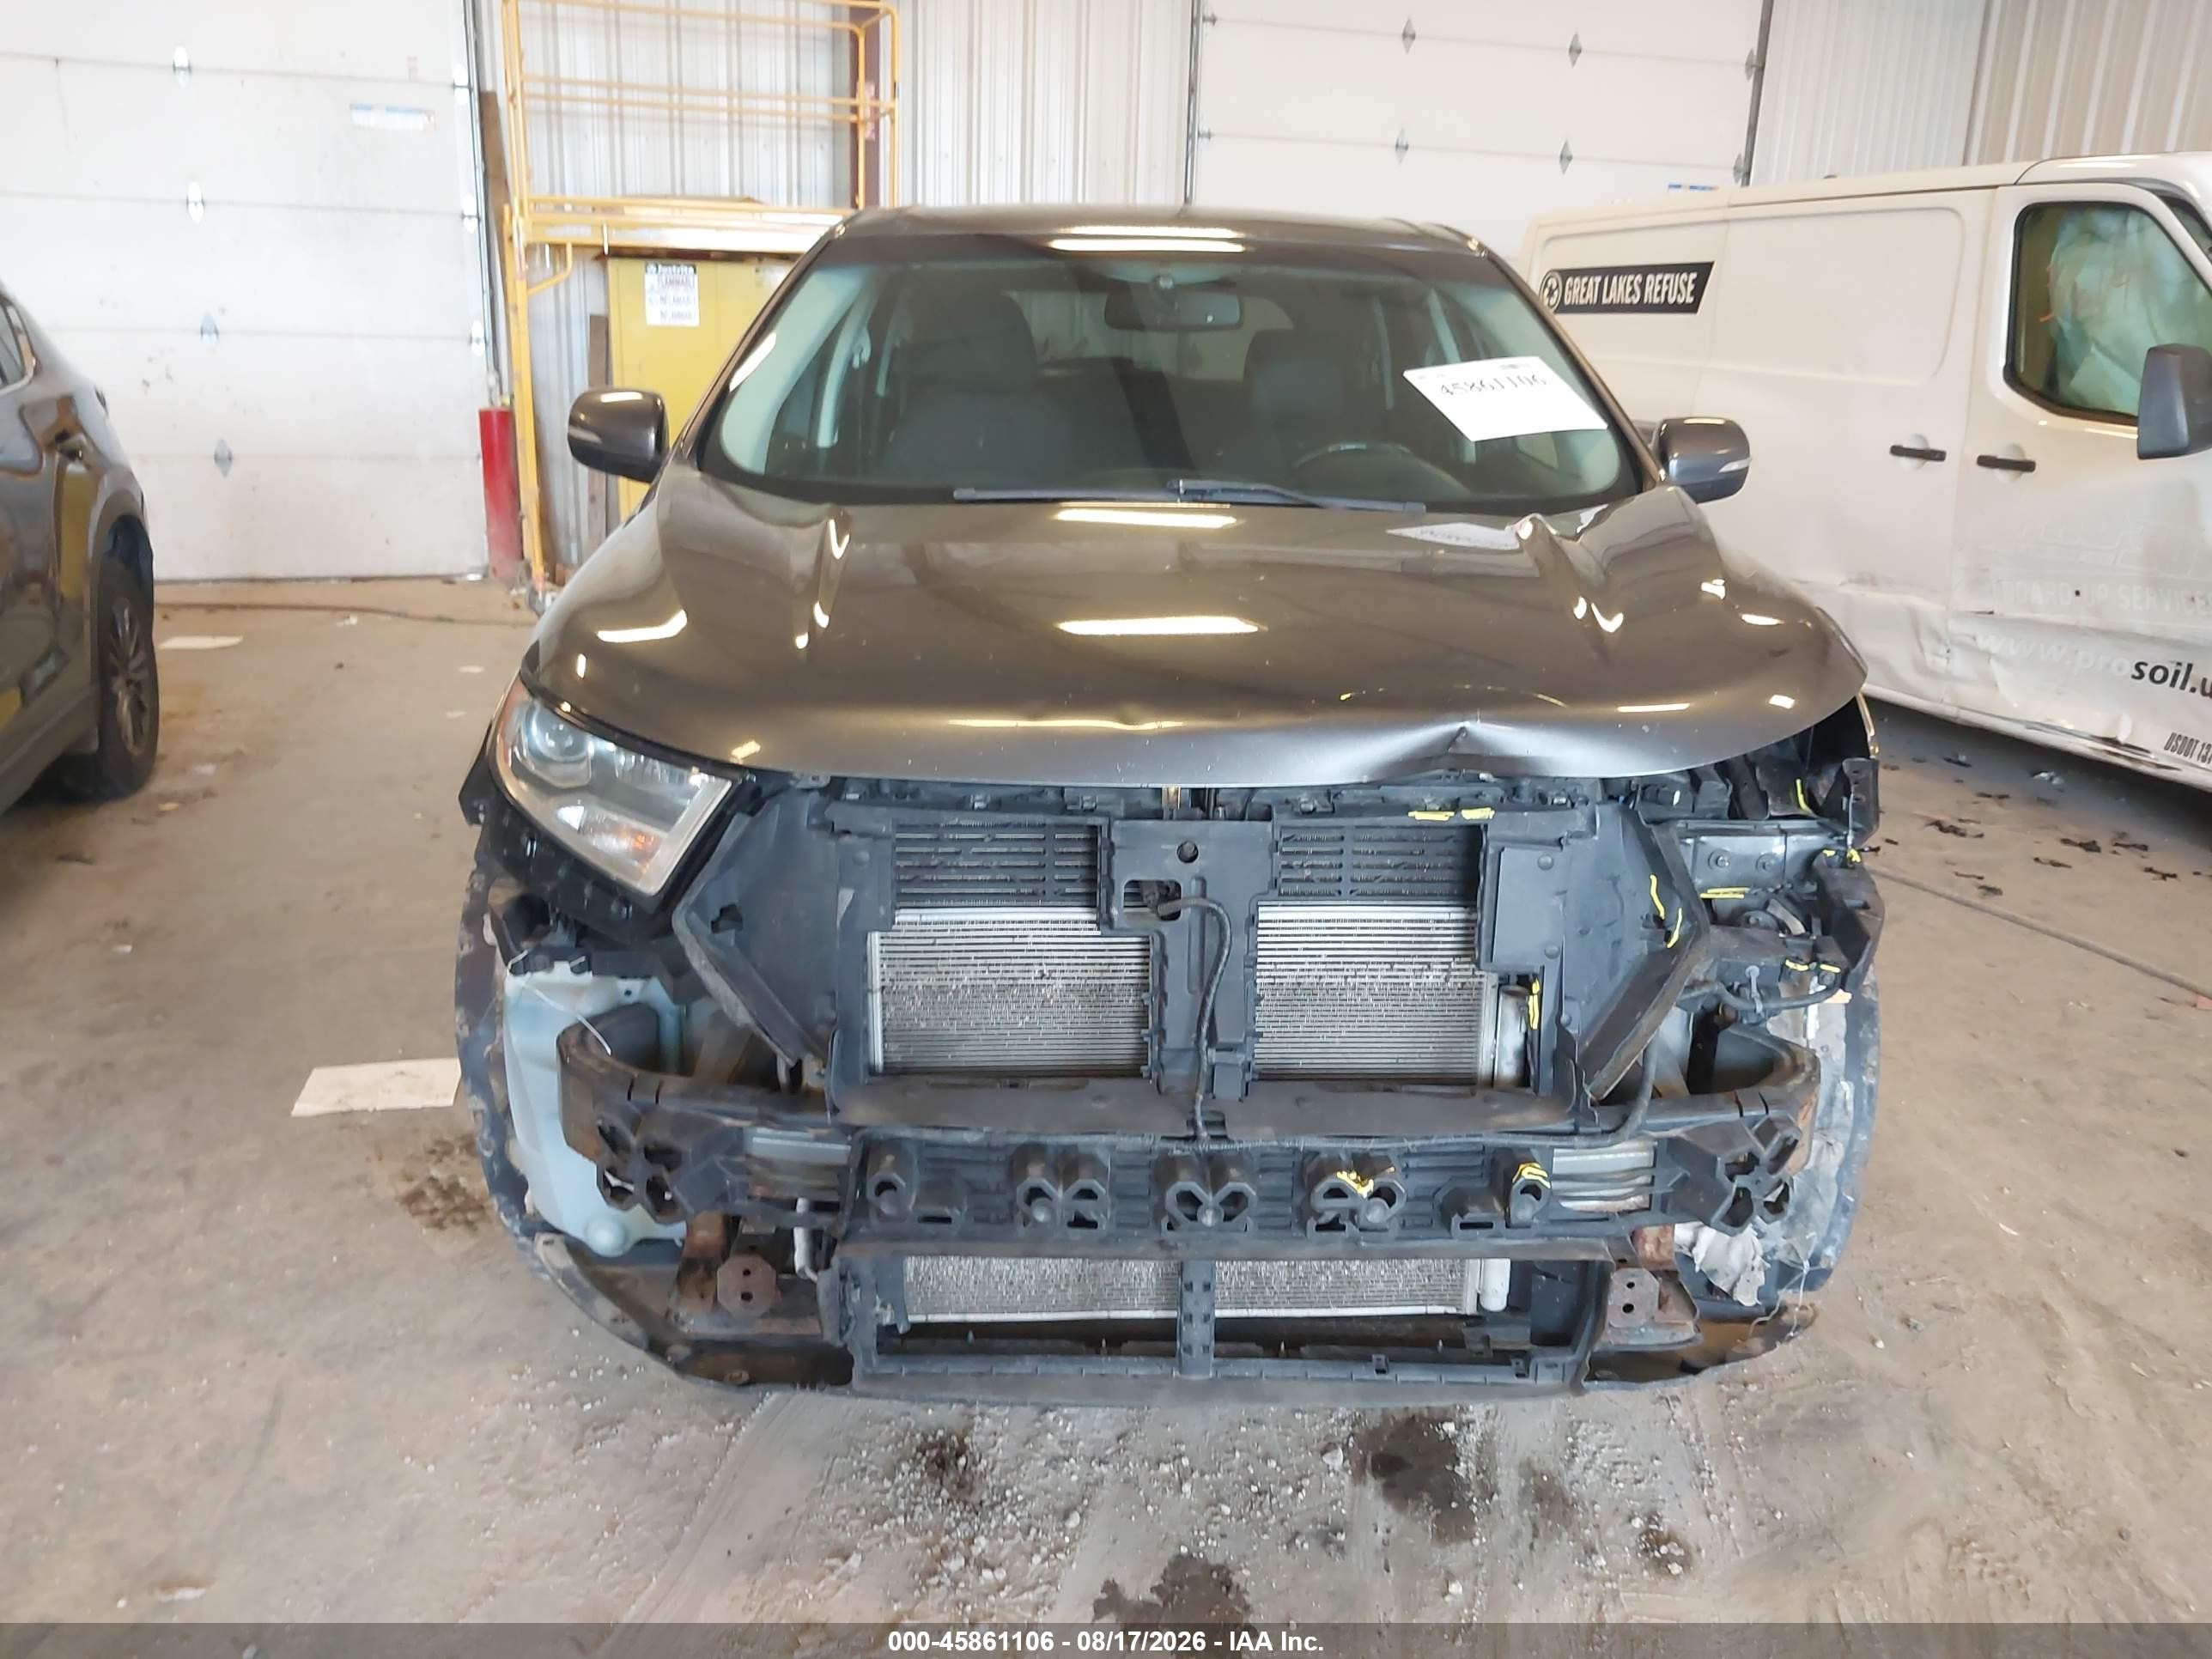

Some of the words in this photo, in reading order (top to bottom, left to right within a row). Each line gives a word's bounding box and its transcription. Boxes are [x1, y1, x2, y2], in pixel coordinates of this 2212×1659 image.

[1564, 275, 1601, 306] GREAT
[1601, 274, 1641, 305] LAKES
[1644, 271, 1698, 305] REFUSE
[2164, 732, 2200, 759] USDOT
